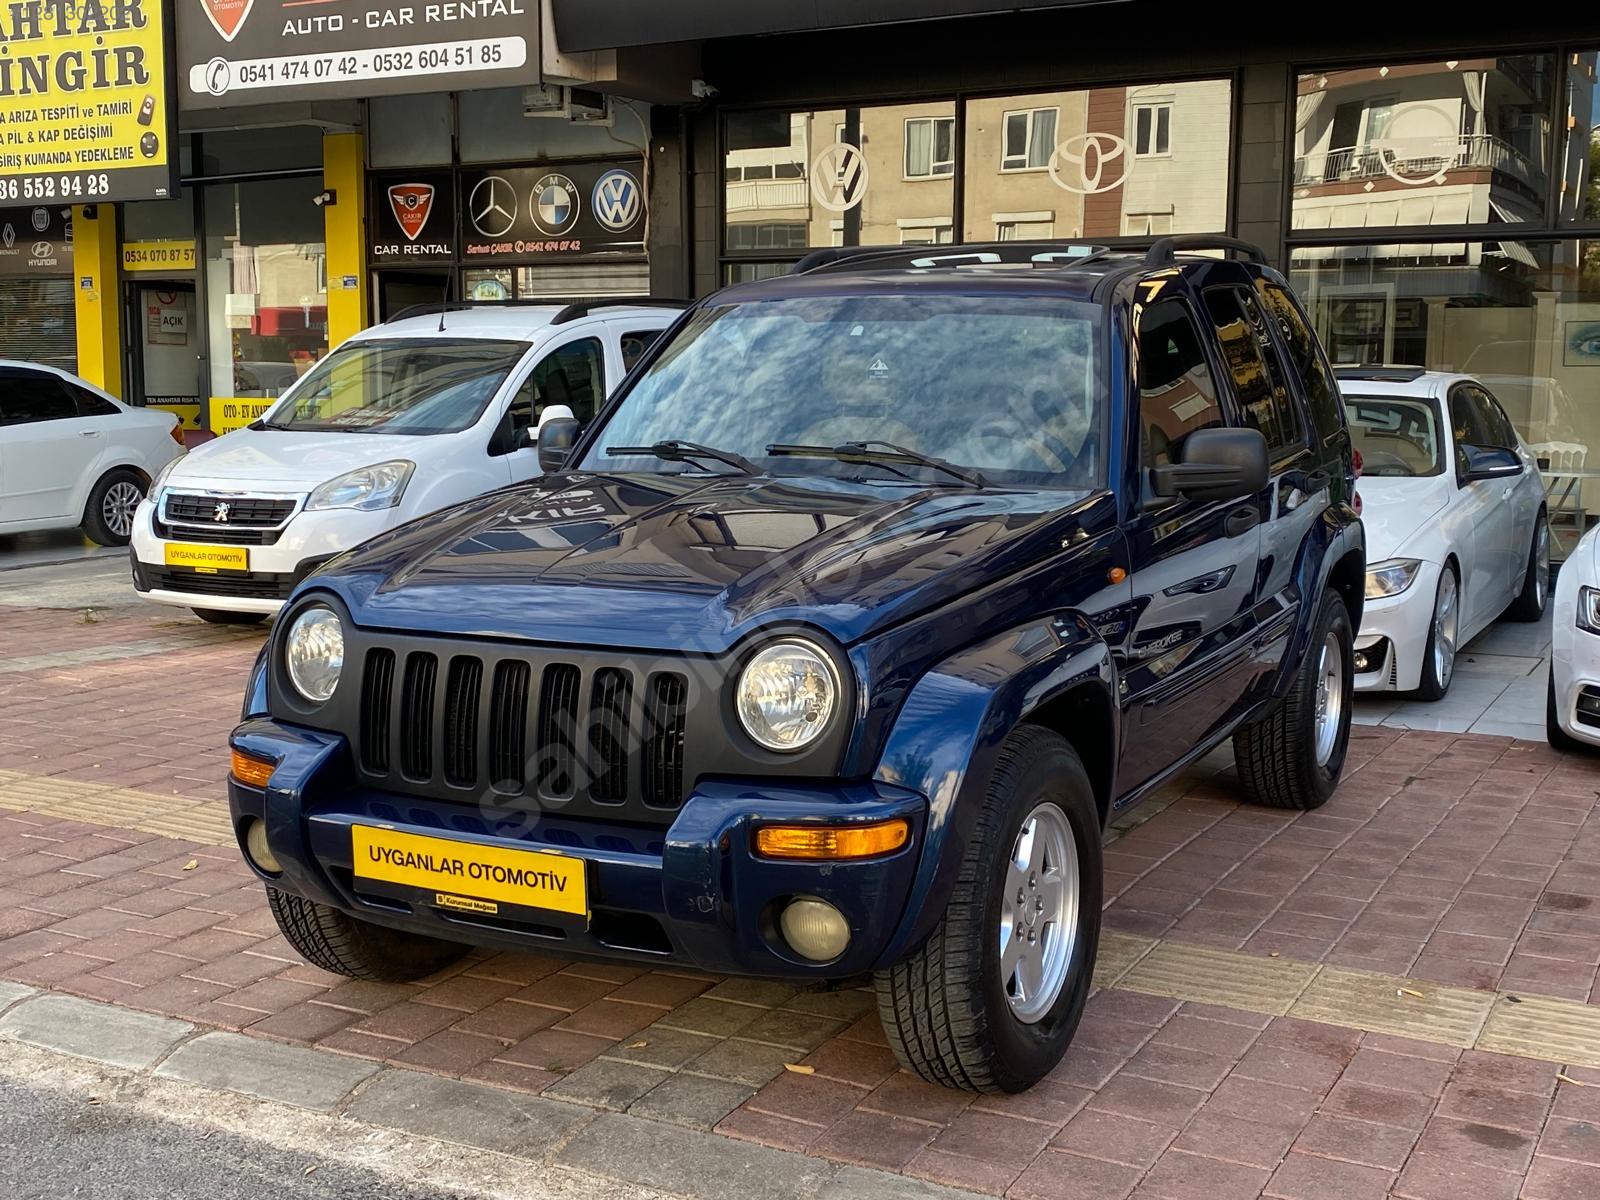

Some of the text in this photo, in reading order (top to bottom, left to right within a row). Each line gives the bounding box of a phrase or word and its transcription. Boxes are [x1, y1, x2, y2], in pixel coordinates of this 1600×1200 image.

[282, 15, 342, 36] AUTO
[366, 6, 414, 28] CAR
[425, 0, 524, 23] RENTAL
[239, 64, 275, 83] 0541
[281, 60, 308, 79] 474
[314, 59, 332, 77] 07
[338, 57, 357, 75] 42
[373, 53, 413, 72] 0532
[418, 50, 449, 69] 604
[455, 47, 474, 65] 51
[481, 44, 502, 63] 85
[9, 109, 38, 124] ARIZA
[41, 103, 79, 121] TESPİTİ
[83, 107, 93, 118] ve
[97, 98, 132, 117] TAMİRİ
[8, 129, 23, 145] PİL
[27, 131, 34, 144] &
[38, 129, 59, 143] KAP
[64, 122, 113, 142] DEĞİŞİMİ
[25, 151, 72, 166] KUMANDA
[75, 146, 134, 162] YEDEKLEME
[24, 177, 55, 198] 552
[60, 175, 82, 197] 94
[88, 173, 109, 195] 28
[534, 176, 575, 194] BMW
[125, 249, 195, 263] 0534 070 87 57
[374, 243, 451, 255] CAR RENTAL
[28, 259, 57, 267] HYUNDAI
[162, 316, 183, 327] AÇIK
[224, 404, 237, 418] OTO
[242, 404, 250, 418] EV
[170, 551, 207, 560] UYGANLAR
[369, 845, 567, 892] UYGANLAR OTOMOTİV
[446, 897, 473, 908] Kurumsal
[474, 902, 497, 912] Mağaza
